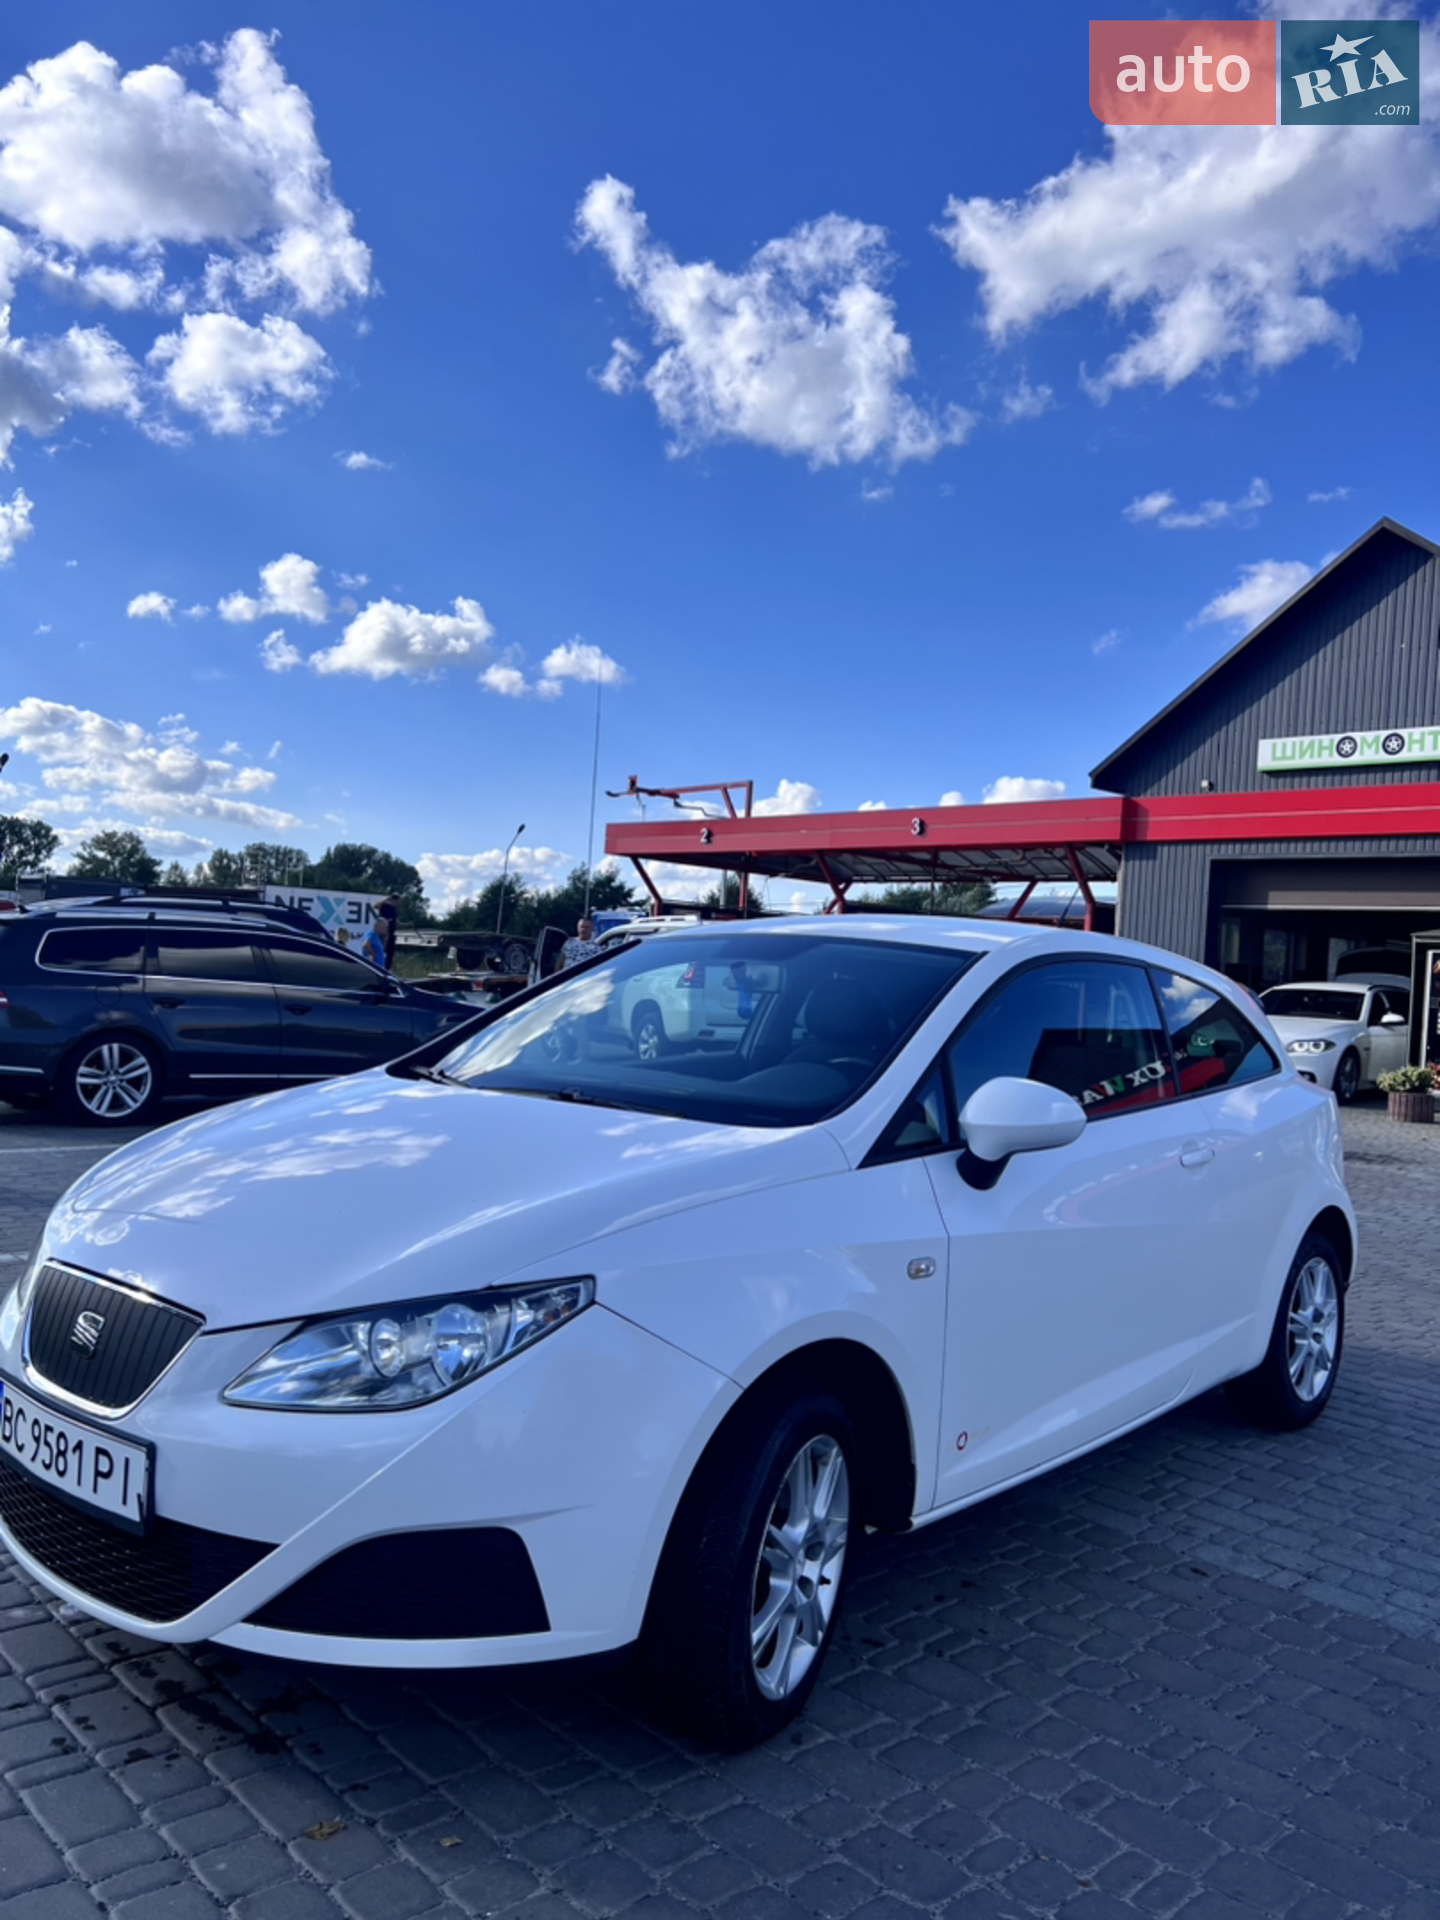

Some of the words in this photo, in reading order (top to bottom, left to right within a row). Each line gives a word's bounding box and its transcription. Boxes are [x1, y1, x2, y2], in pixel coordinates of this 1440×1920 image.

[911, 817, 922, 835] 3
[700, 828, 710, 843] 2
[2, 1397, 27, 1453] BC
[30, 1418, 84, 1487] 9581
